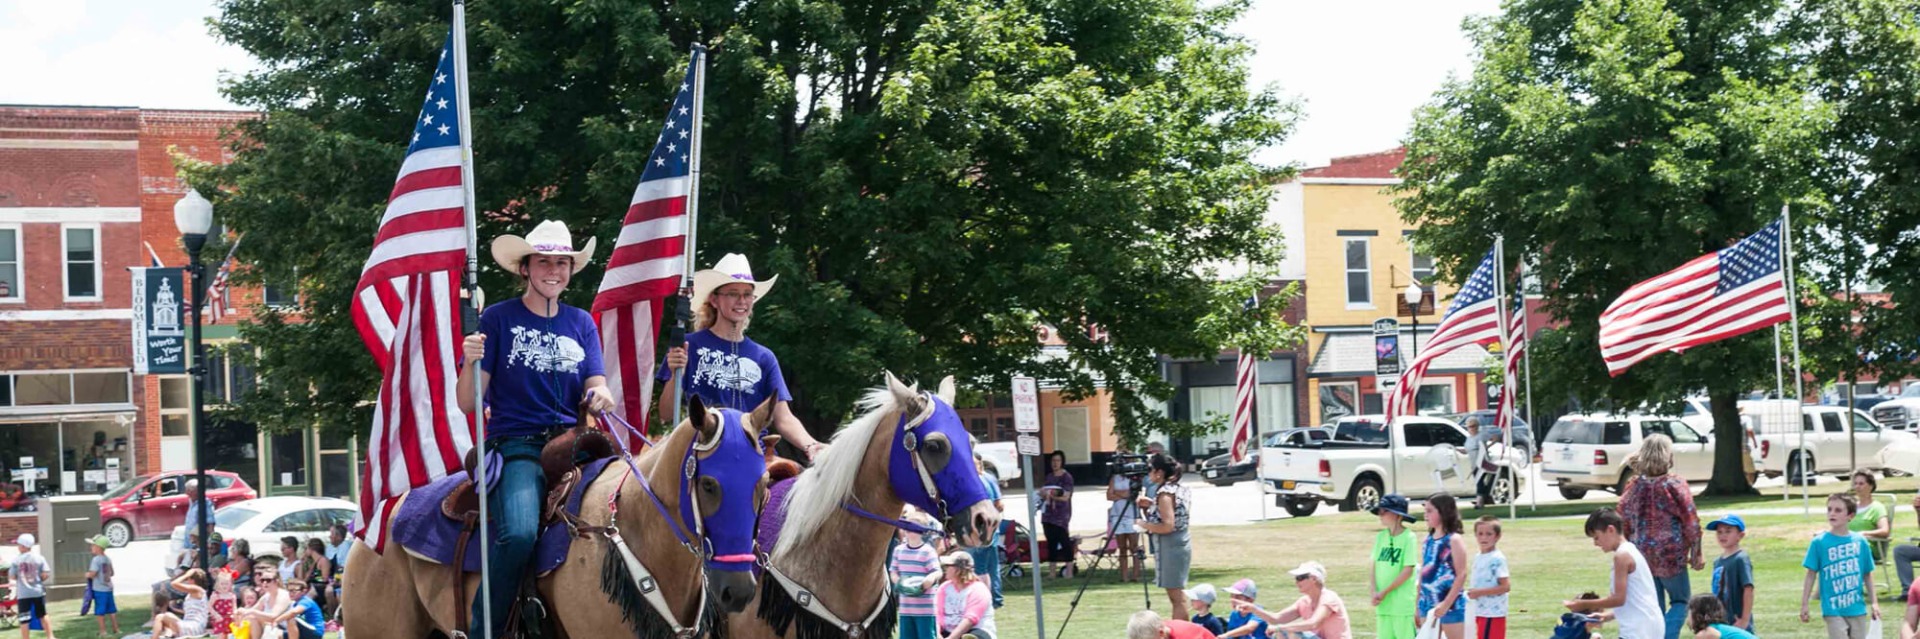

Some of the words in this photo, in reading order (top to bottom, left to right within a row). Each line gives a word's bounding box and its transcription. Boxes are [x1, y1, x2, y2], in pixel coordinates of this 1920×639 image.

[134, 279, 145, 363] BLOOMFIELD
[149, 337, 177, 348] Worth
[161, 345, 182, 357] Your
[1828, 541, 1861, 561] BEEN
